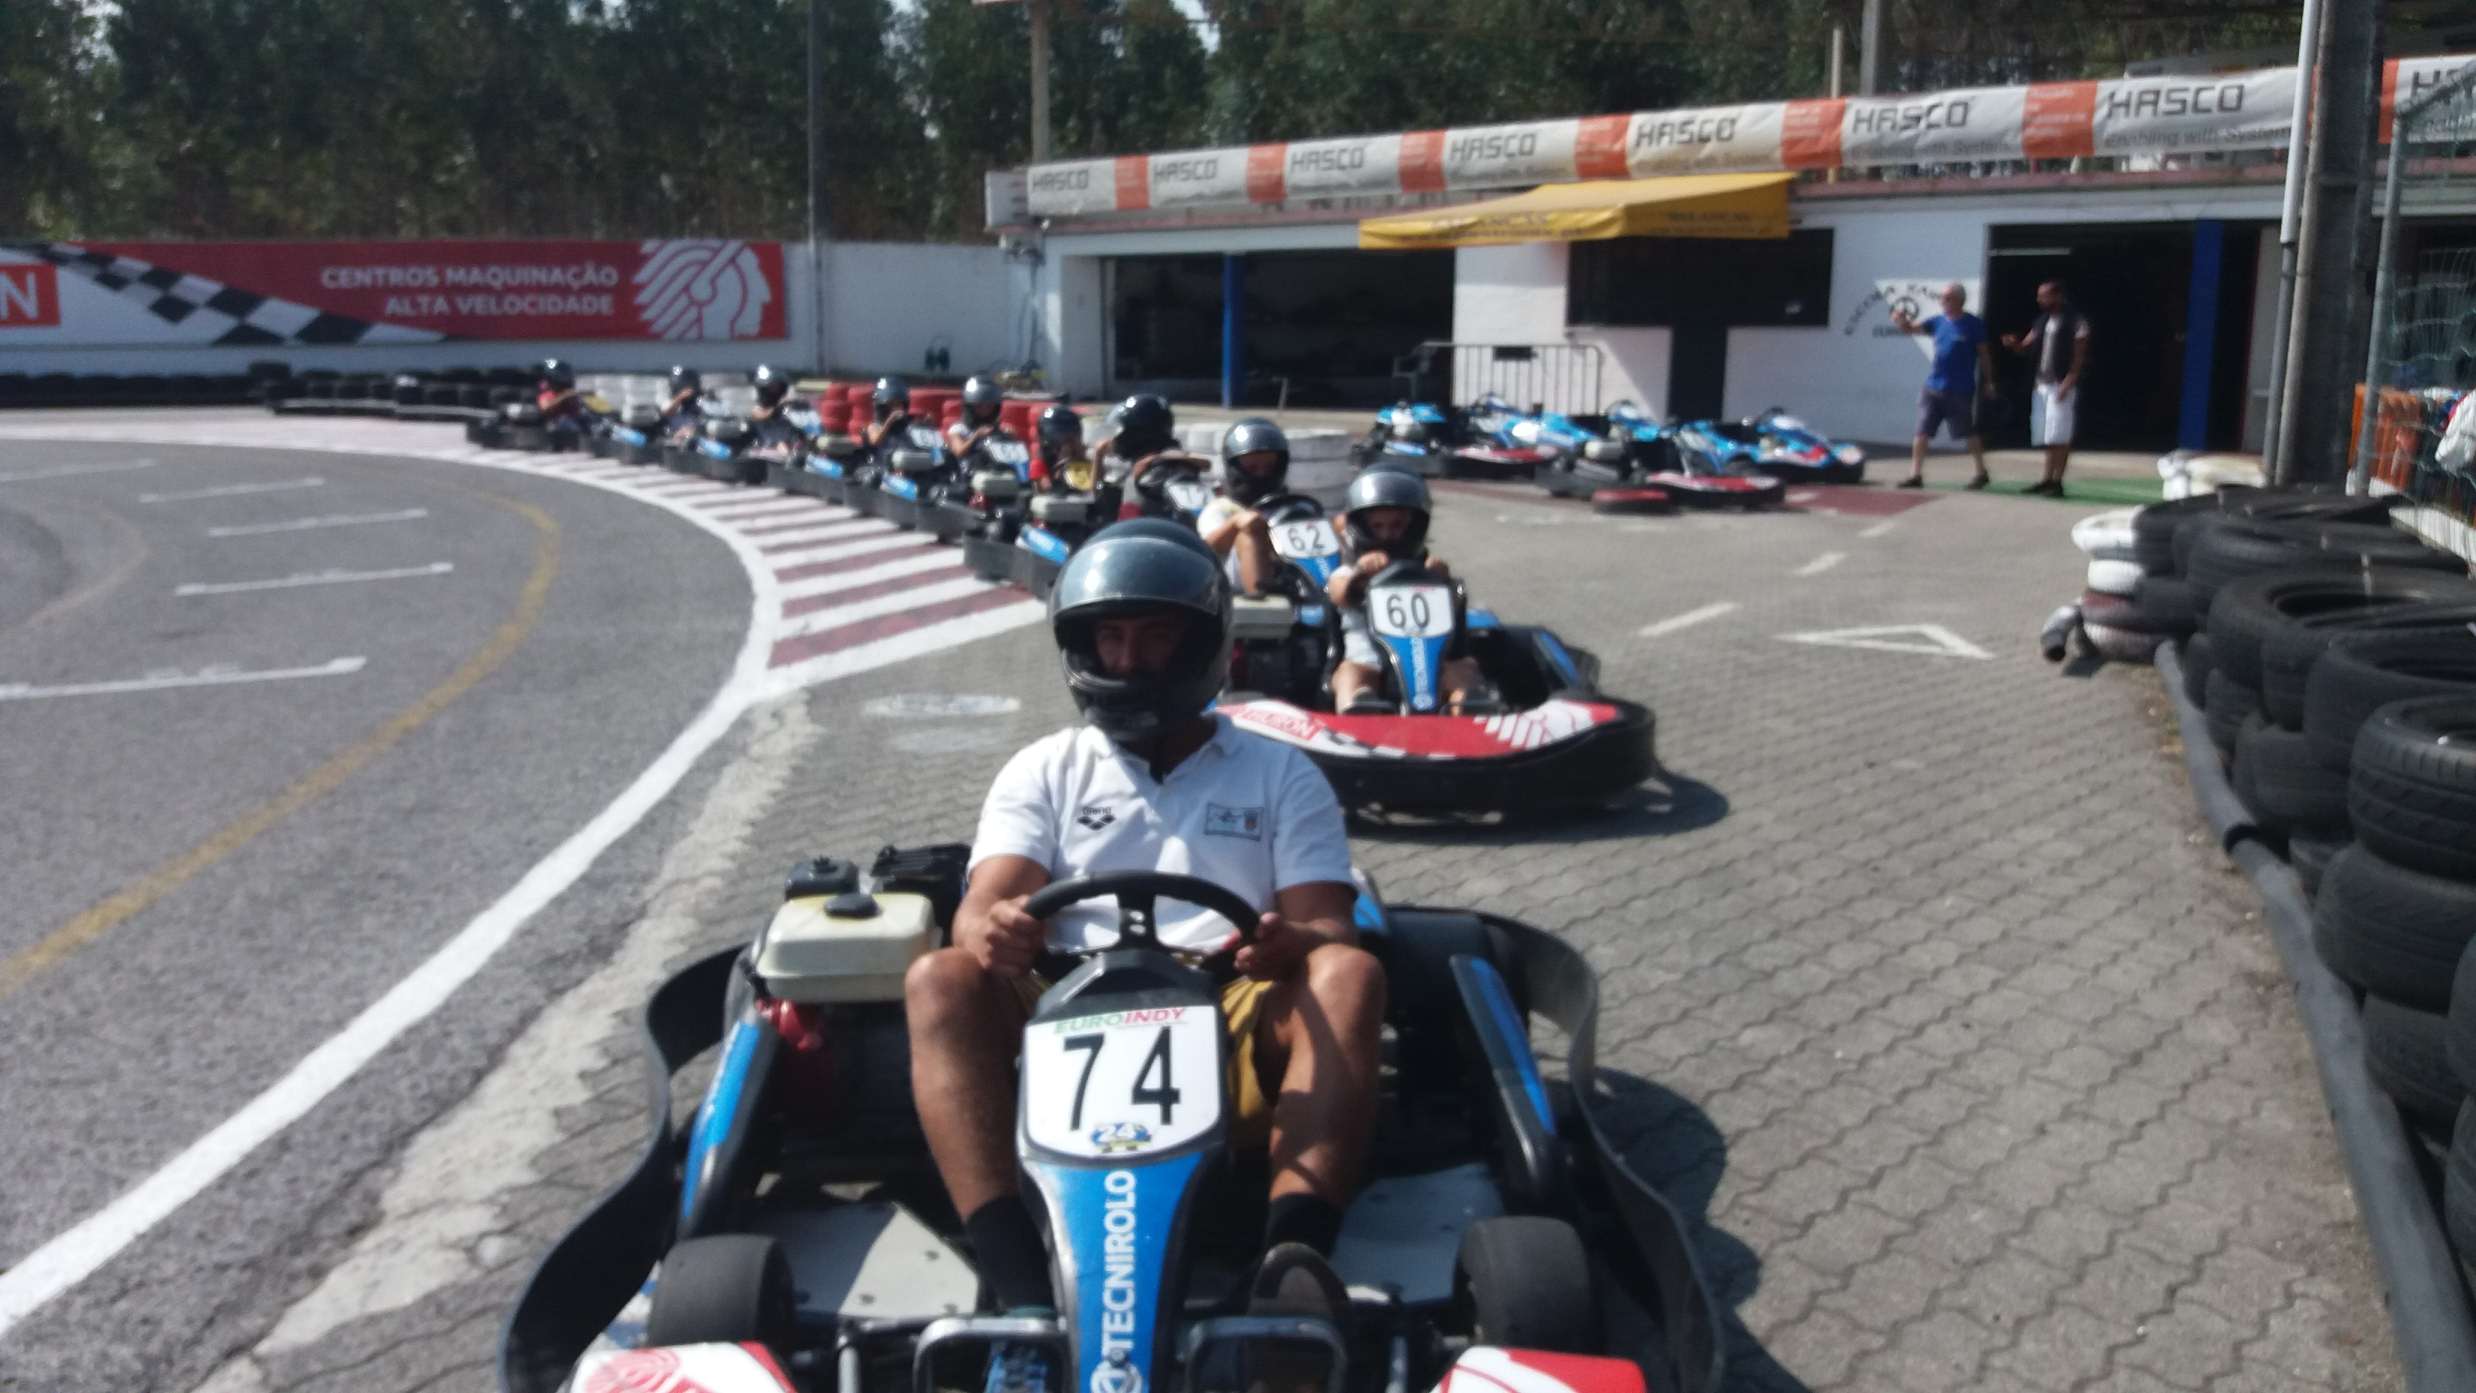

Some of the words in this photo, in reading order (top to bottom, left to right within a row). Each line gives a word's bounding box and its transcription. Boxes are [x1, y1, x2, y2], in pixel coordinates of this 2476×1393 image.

[2105, 83, 2245, 119] HASCO
[1852, 101, 1970, 134] HASCO
[1635, 116, 1739, 148] HASCO
[1290, 148, 1364, 172] HASCO
[1450, 133, 1538, 161] HASCO
[1031, 168, 1090, 192] HASCO
[1152, 158, 1219, 184] HASCO
[321, 266, 440, 288] CENTROS
[446, 262, 619, 290] MAQUINAÇÃO
[384, 296, 449, 315] ALTA
[457, 295, 614, 315] VELOCIDADE
[1287, 525, 1325, 552] 62
[1386, 592, 1431, 630] 60
[1054, 1007, 1185, 1034] EUROINDY
[1063, 1025, 1181, 1132] 74
[1102, 1169, 1137, 1359] TECNIROLO
